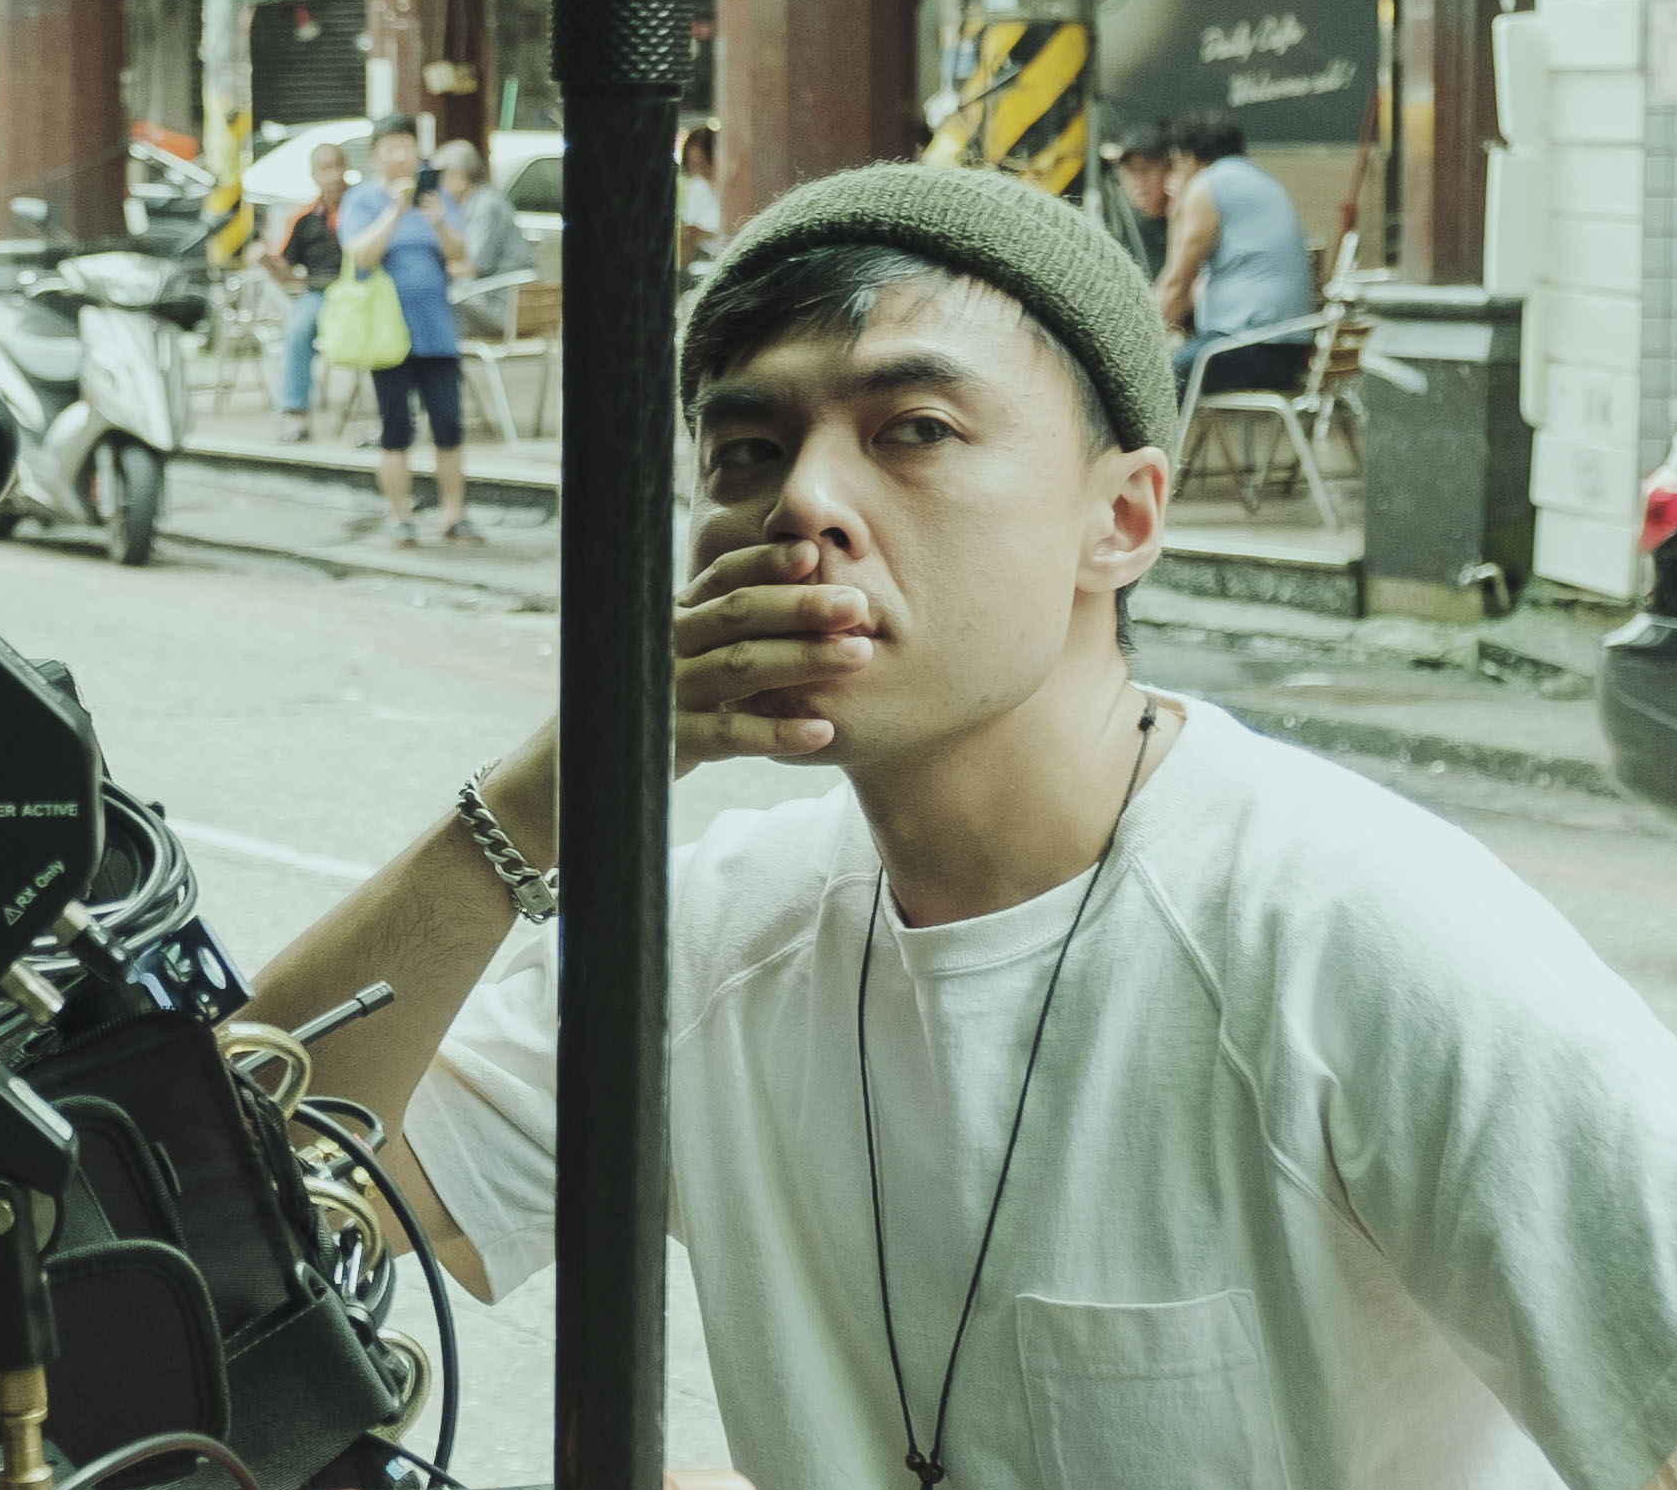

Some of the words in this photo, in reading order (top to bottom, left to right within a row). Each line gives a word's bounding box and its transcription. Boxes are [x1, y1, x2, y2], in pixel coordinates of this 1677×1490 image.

[21, 803, 78, 817] ACTIVE
[15, 887, 38, 908] RX
[35, 860, 66, 888] Only
